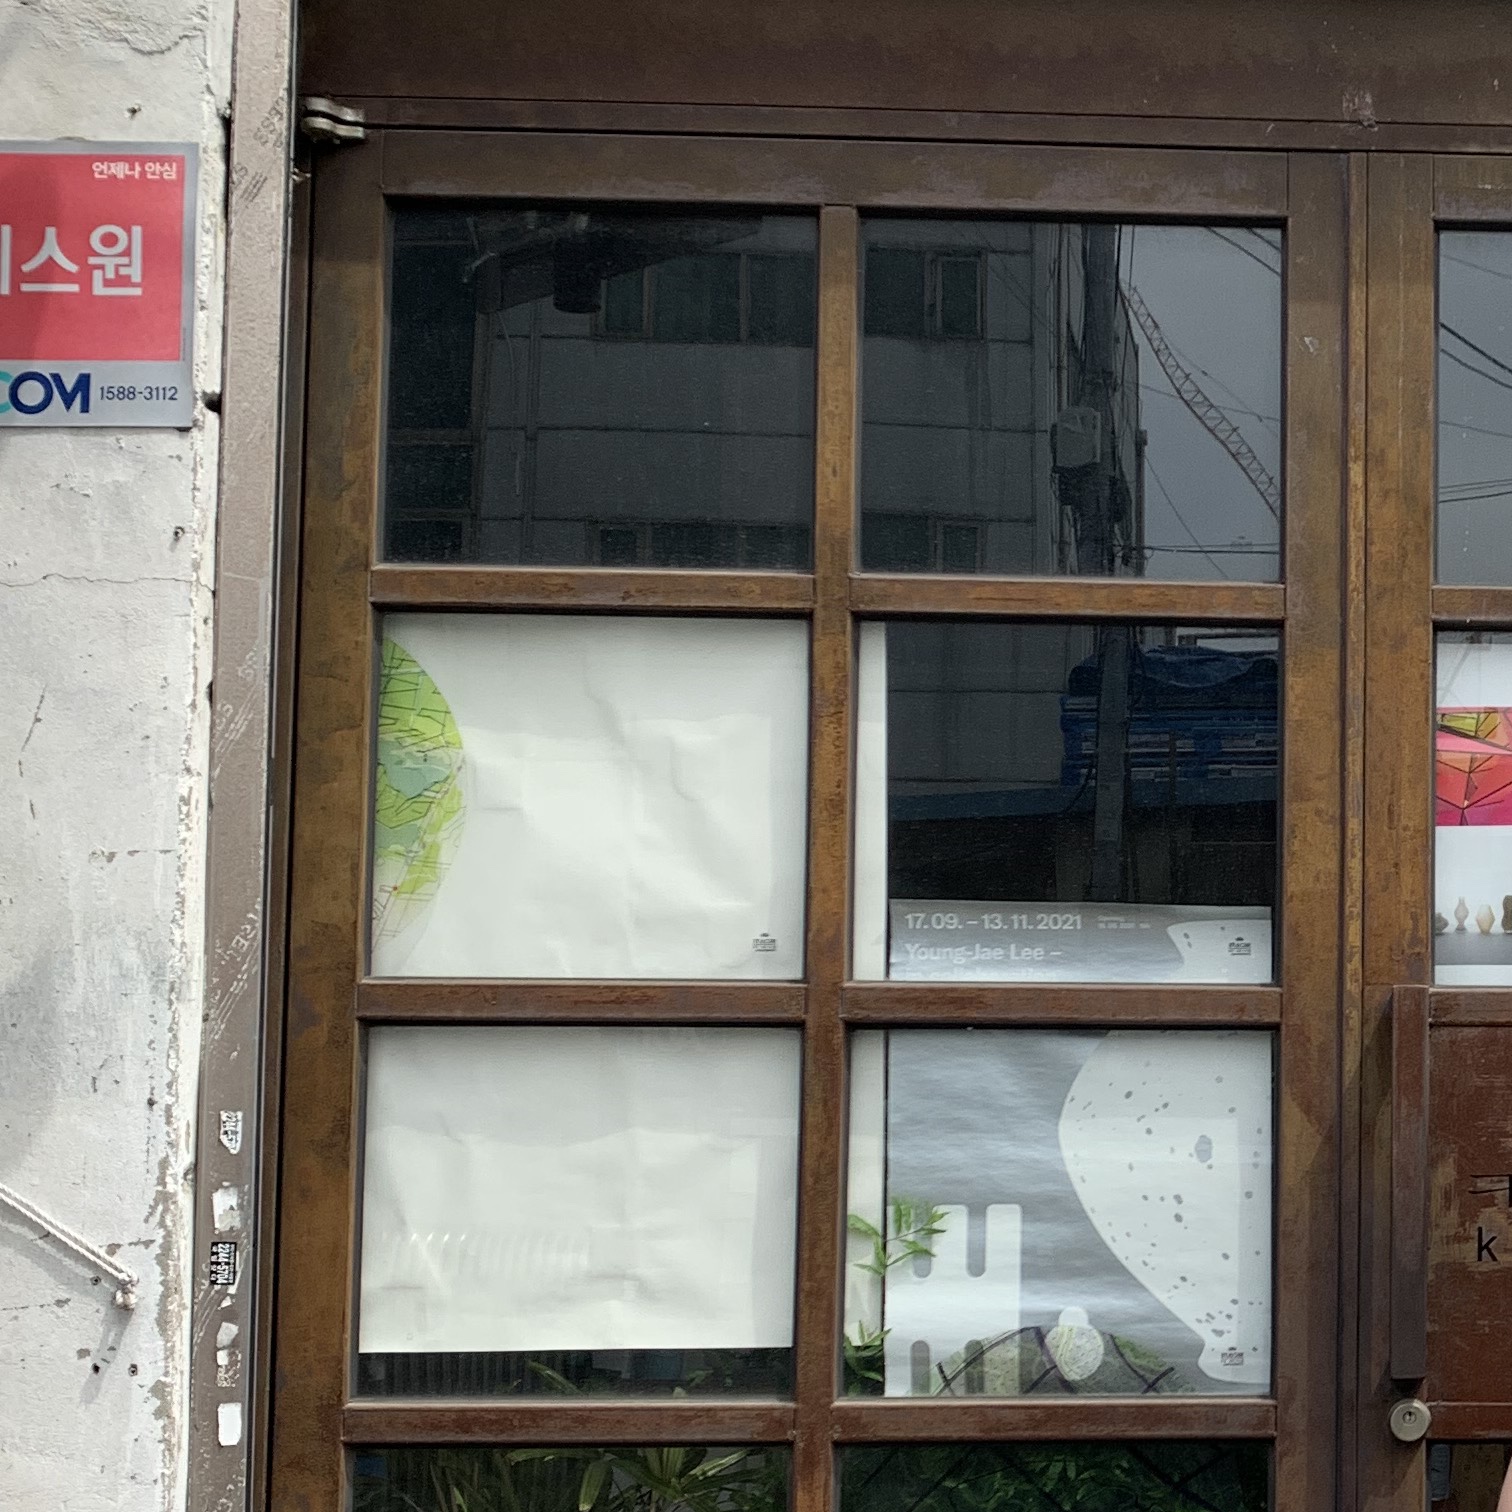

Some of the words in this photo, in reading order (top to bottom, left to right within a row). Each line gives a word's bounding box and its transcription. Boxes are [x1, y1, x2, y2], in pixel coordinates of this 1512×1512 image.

[92, 161, 141, 179] 언제나
[145, 161, 177, 179] 안심
[100, 386, 178, 401] 1588-3112
[904, 943, 1005, 964] Young-Jae
[1010, 943, 1045, 960] Lee
